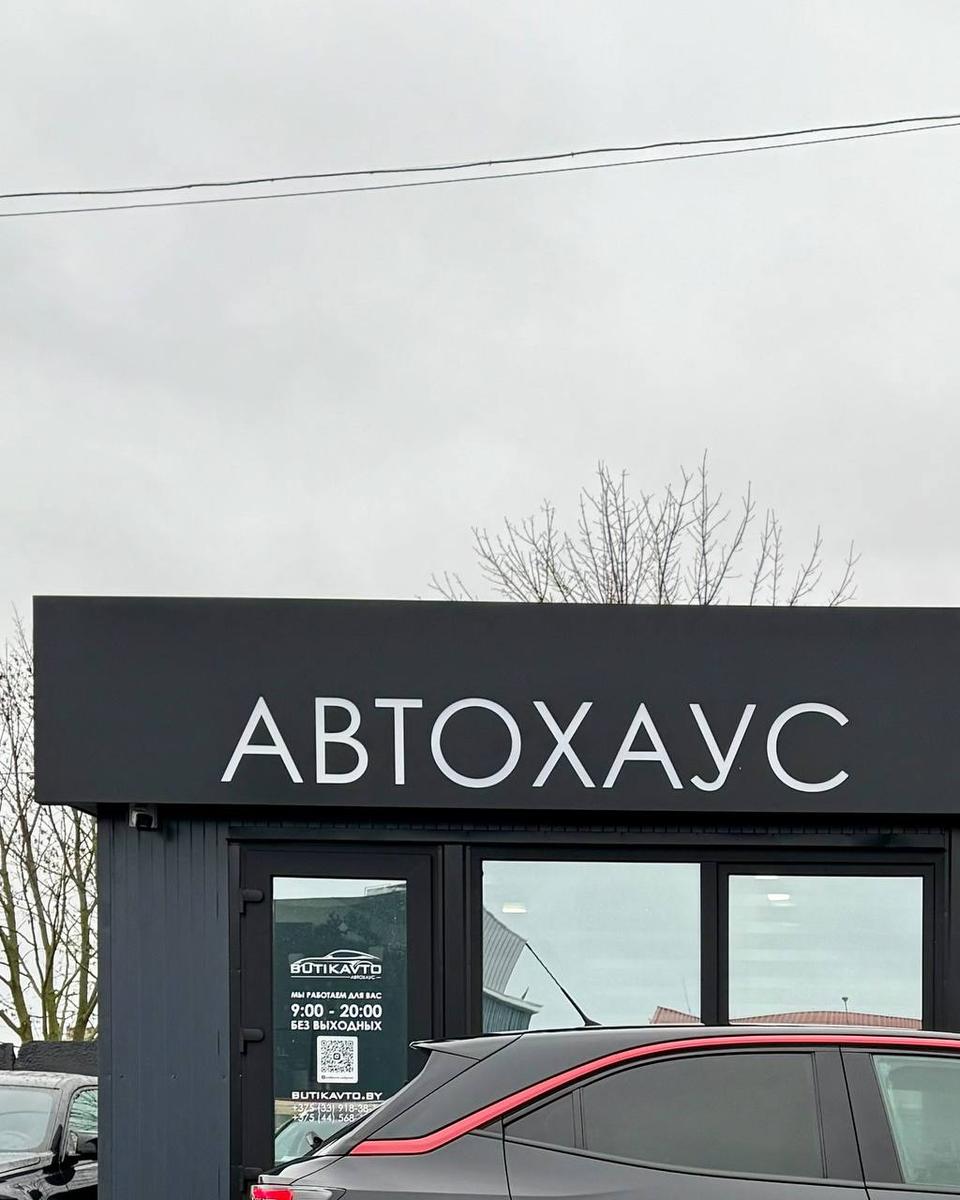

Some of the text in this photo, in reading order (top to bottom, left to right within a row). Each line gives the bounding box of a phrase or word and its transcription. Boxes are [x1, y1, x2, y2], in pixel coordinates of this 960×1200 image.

[220, 696, 850, 793] АВТОХАУС
[290, 964, 382, 975] BUTIKAVTO
[291, 991, 305, 999] МЫ
[306, 991, 347, 999] РАБОТАЕМ
[290, 1003, 324, 1018] 9:00
[339, 1004, 383, 1018] 20:00
[290, 1020, 382, 1032] БЕЗ ВЫХОДНЫХ
[291, 1091, 383, 1100] BUTIKAVTO.BY
